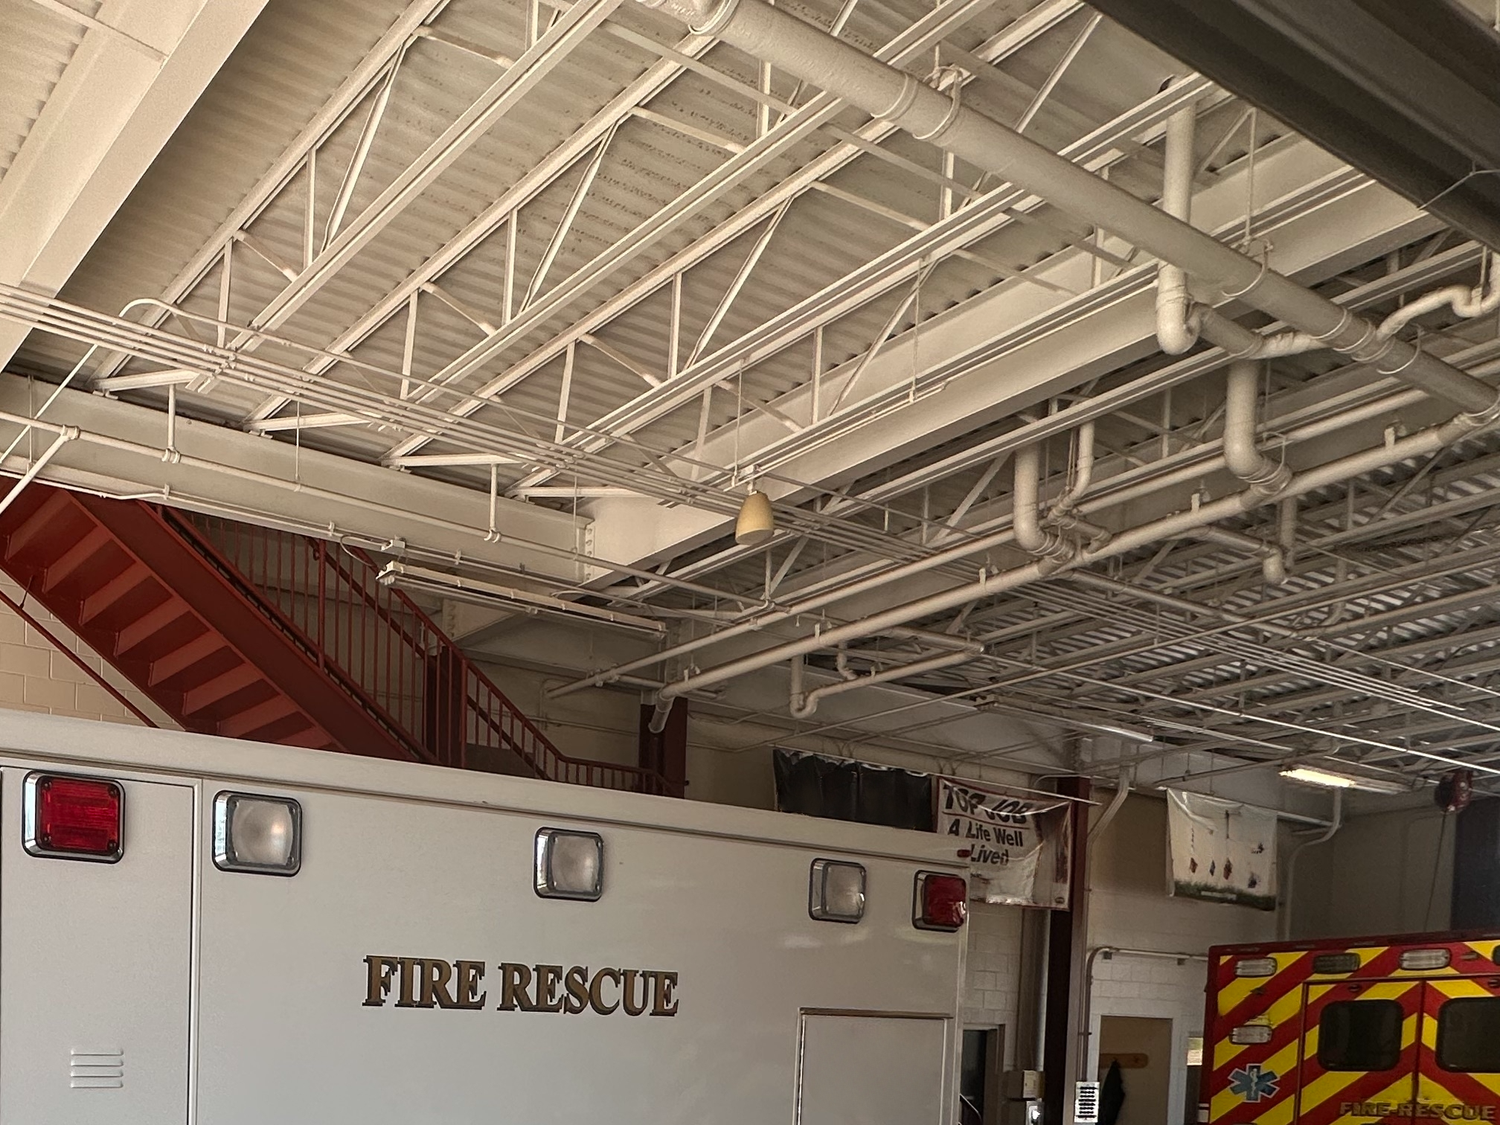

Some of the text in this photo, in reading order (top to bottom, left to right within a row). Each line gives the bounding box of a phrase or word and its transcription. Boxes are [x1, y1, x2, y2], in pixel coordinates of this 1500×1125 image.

[942, 783, 1034, 824] TOP JOB
[947, 818, 1024, 848] A Life Well
[970, 843, 1009, 866] Lived
[361, 954, 680, 1017] FIRE RESCUE
[1339, 1101, 1497, 1121] FIRE-RESCUE
